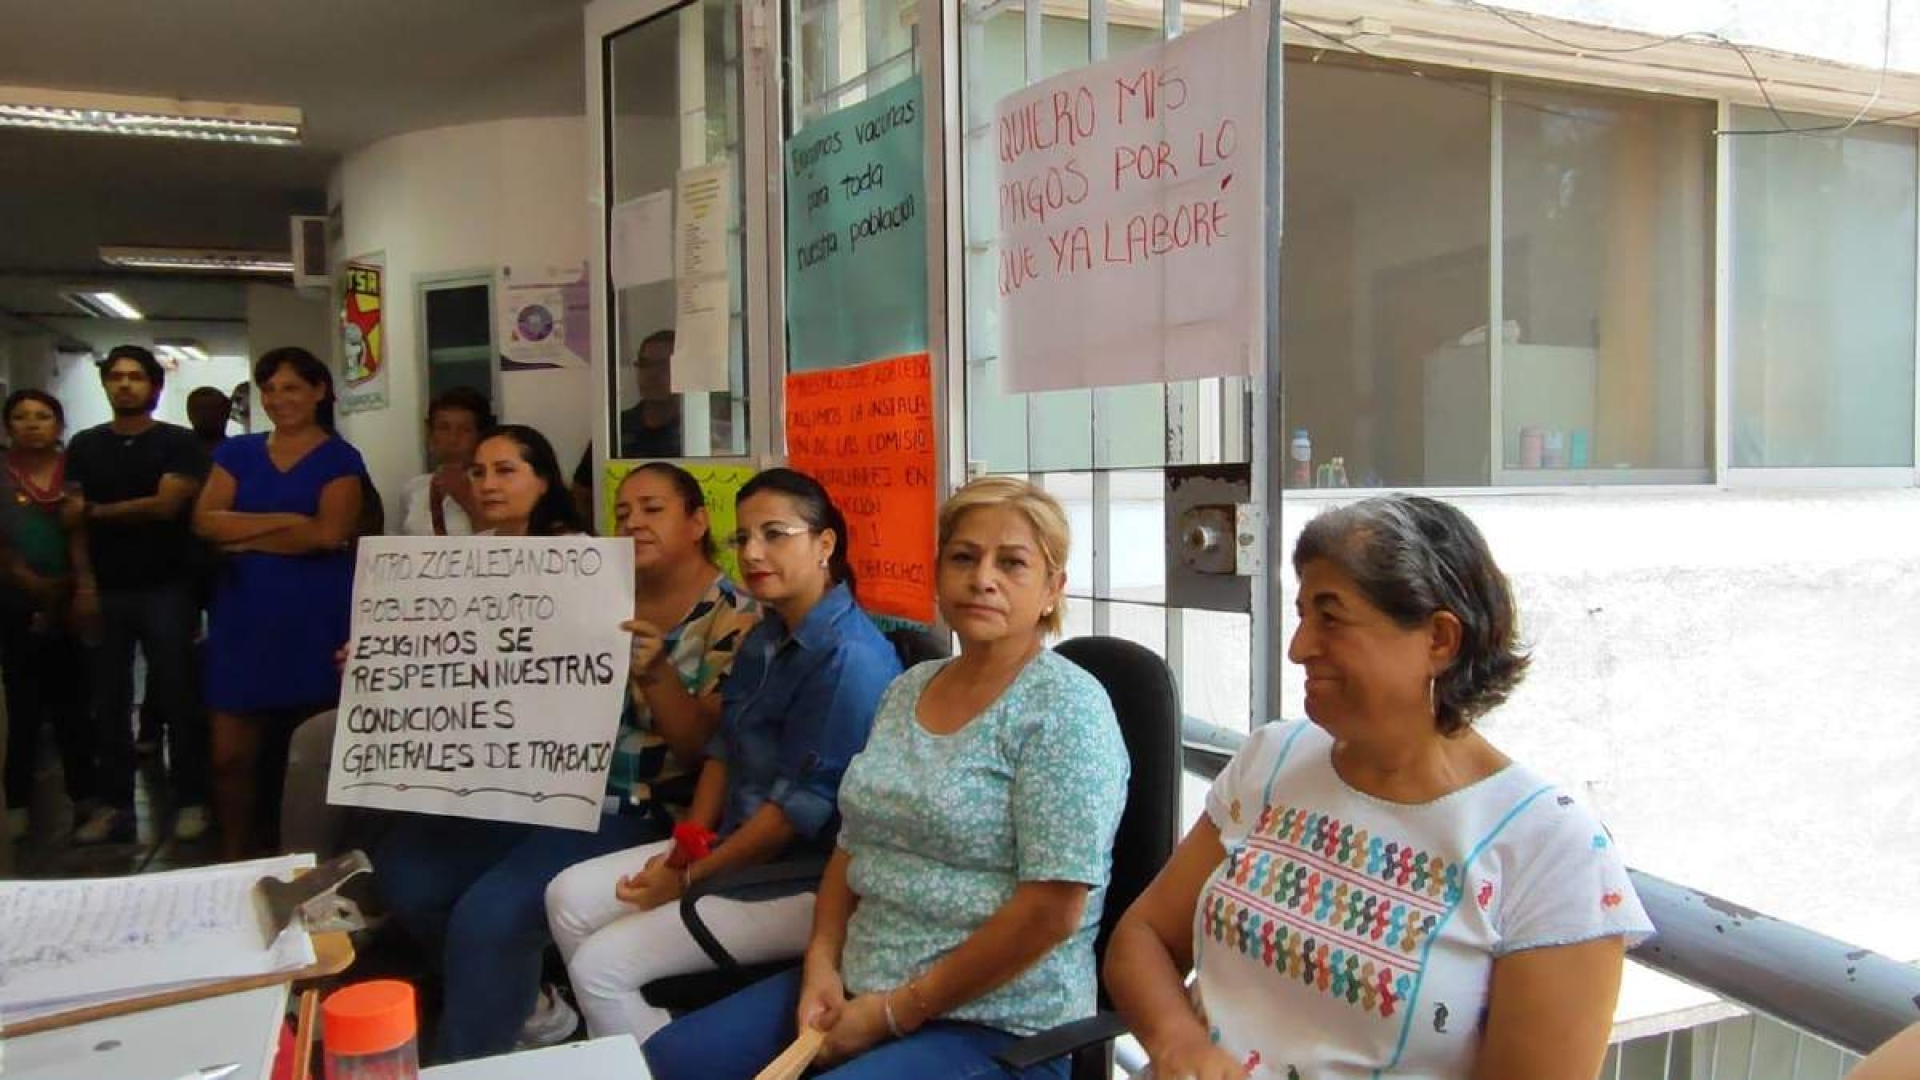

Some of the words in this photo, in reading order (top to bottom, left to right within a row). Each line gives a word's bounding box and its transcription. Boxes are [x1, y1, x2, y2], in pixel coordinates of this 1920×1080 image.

[855, 98, 916, 145] vacunas
[999, 86, 1095, 163] QUIERO
[1115, 65, 1187, 124] MIS
[840, 162, 884, 200] toda
[999, 158, 1088, 231] PAGOS
[1114, 140, 1178, 191] POR
[1197, 119, 1239, 167] LO
[998, 245, 1038, 297] QUE
[1048, 226, 1092, 274] YA
[905, 464, 928, 487] EN
[462, 546, 602, 578] ALEJANDRO
[463, 592, 555, 622] ABURTO
[354, 631, 478, 660] EXIGIMOS
[497, 627, 535, 653] SE
[351, 661, 491, 693] RESPETEN
[494, 652, 615, 687] NUESTRAS
[346, 699, 516, 734] CONDICIONES
[342, 741, 475, 779] GENERALES
[485, 742, 522, 769] DE
[529, 740, 612, 774] TRABAJO
